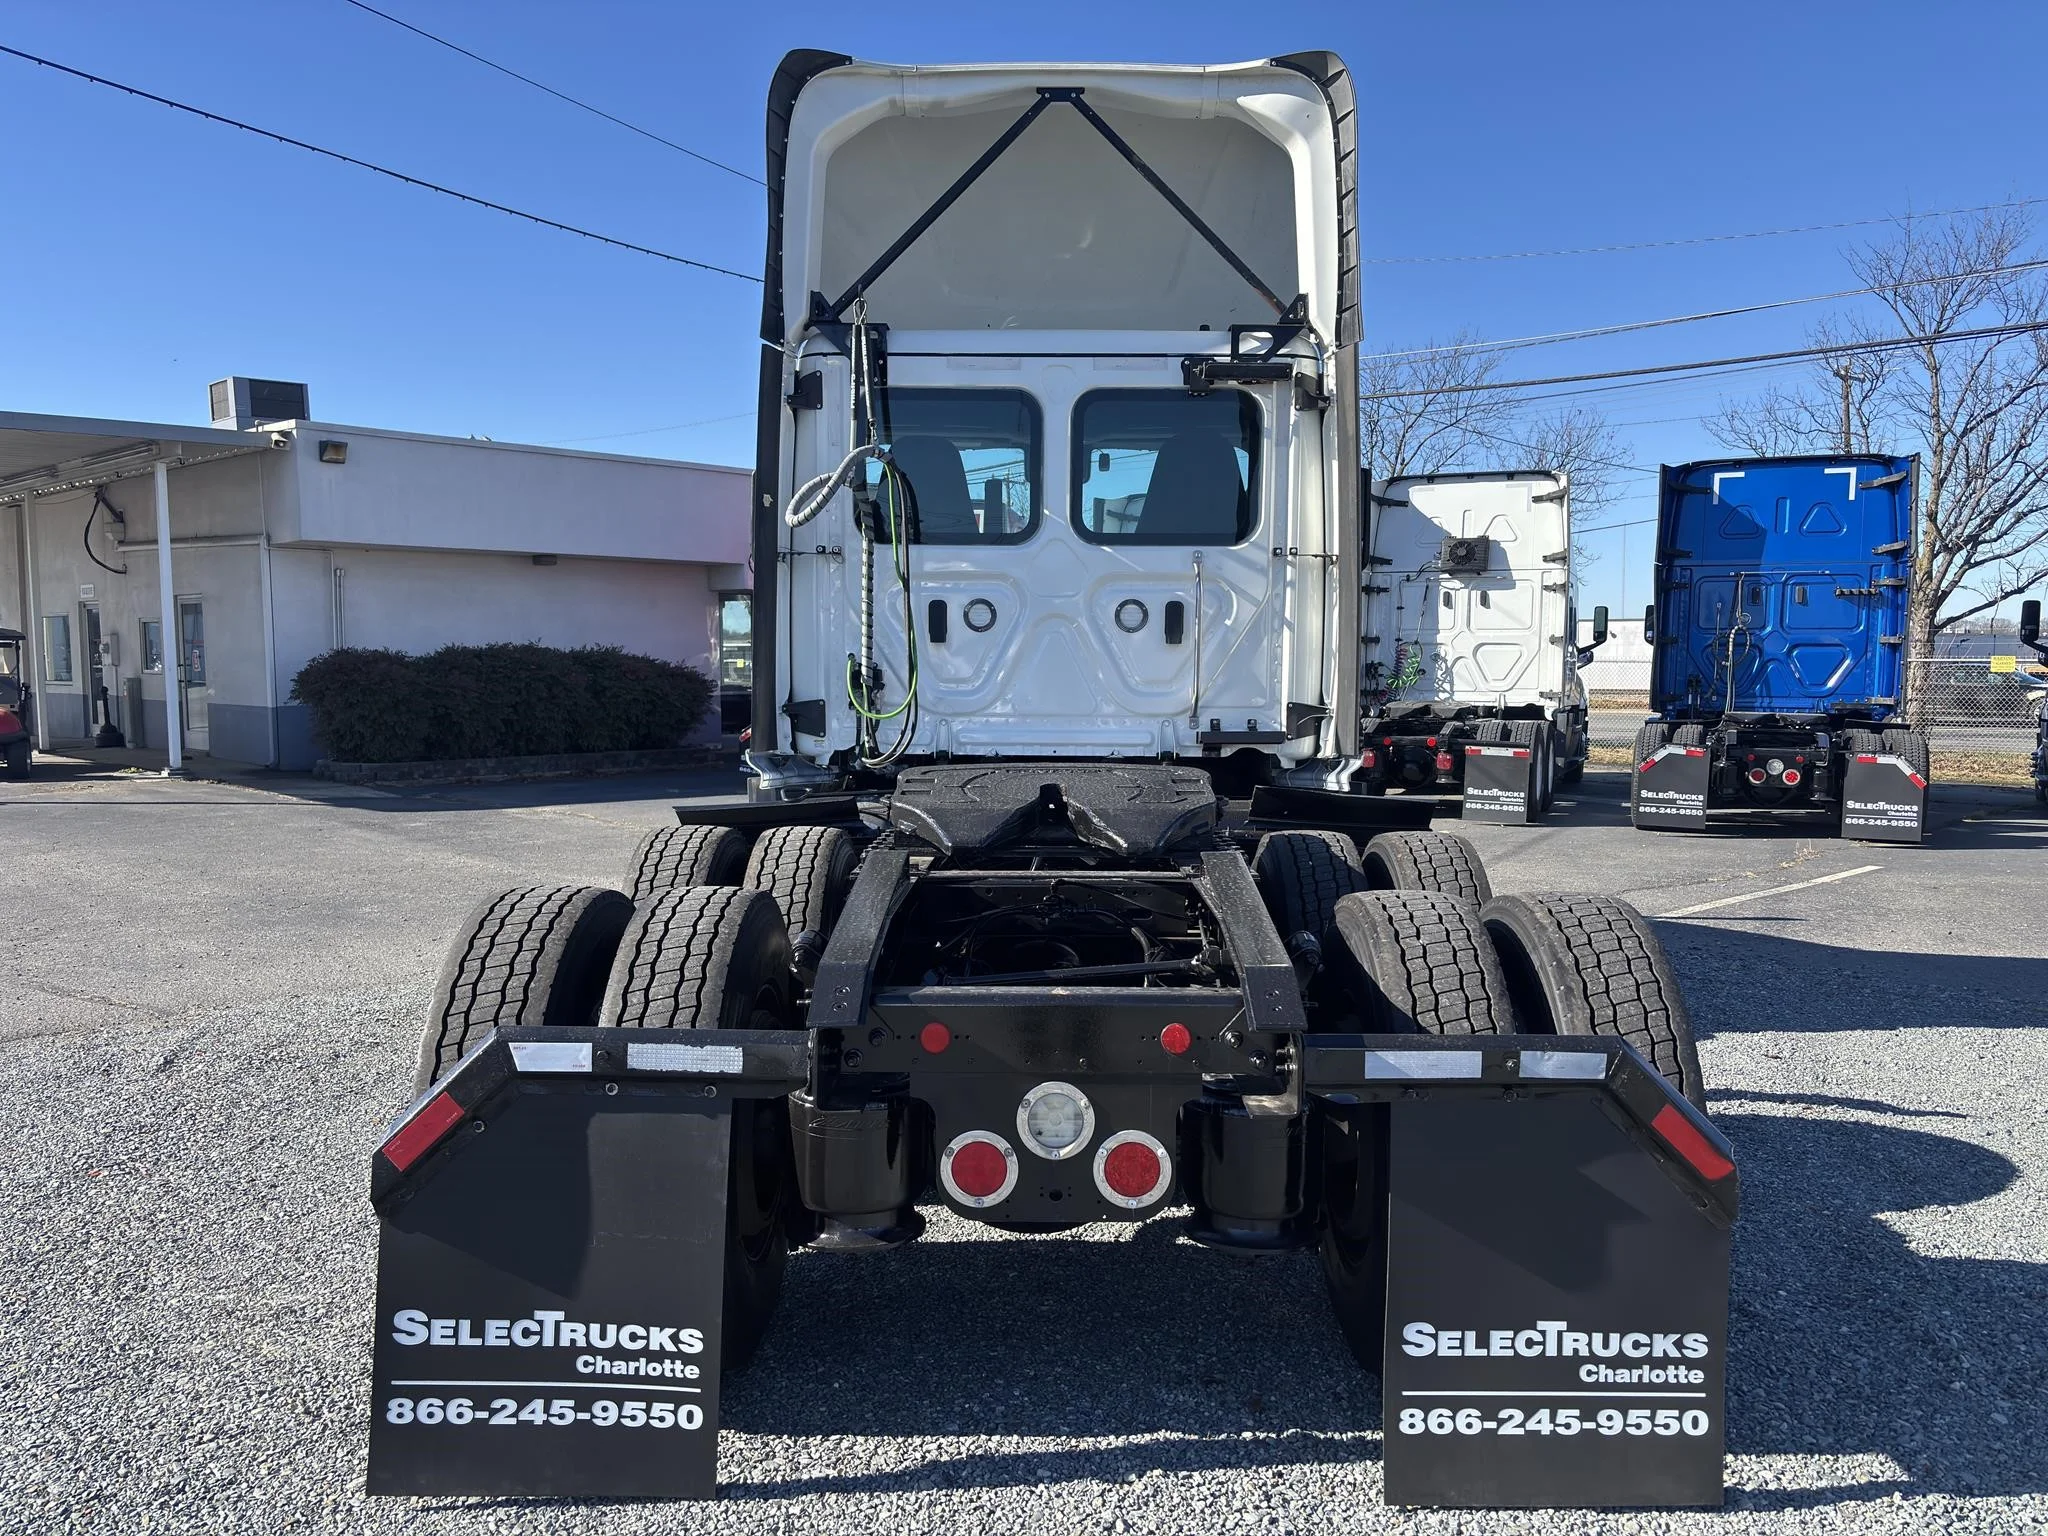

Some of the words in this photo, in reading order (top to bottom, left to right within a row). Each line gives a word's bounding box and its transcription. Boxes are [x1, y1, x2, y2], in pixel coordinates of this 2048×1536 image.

[1638, 806, 1703, 816] 866-245-9550
[1845, 817, 1918, 828] 866-245-9550
[575, 1354, 701, 1379] Charlotte
[1578, 1363, 1706, 1384] Charlotte
[386, 1397, 705, 1431] 866-245-9550
[1398, 1407, 1710, 1436] 866-245-9550
